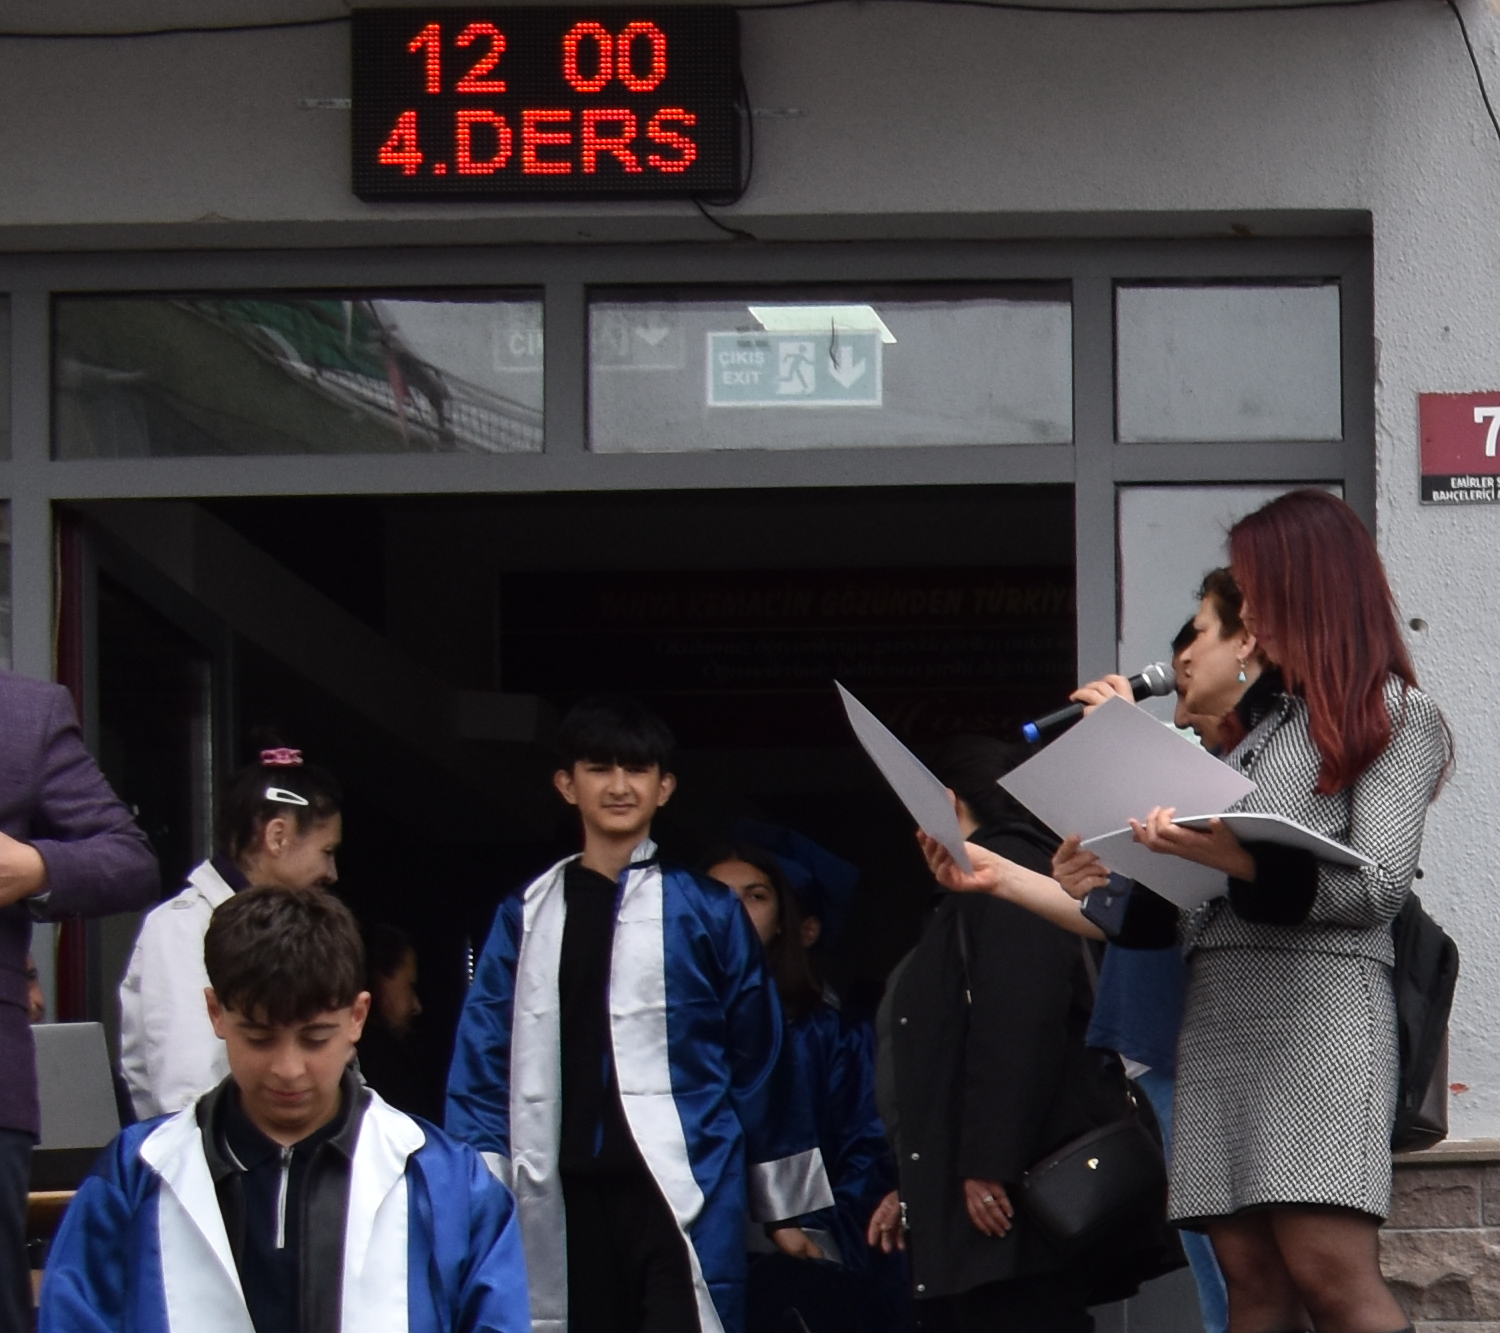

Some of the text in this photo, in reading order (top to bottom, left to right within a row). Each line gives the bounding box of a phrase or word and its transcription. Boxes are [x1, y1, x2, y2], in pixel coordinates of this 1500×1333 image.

[407, 21, 666, 94] 12 00
[377, 108, 697, 177] 4.DERS
[723, 371, 761, 385] EXIT
